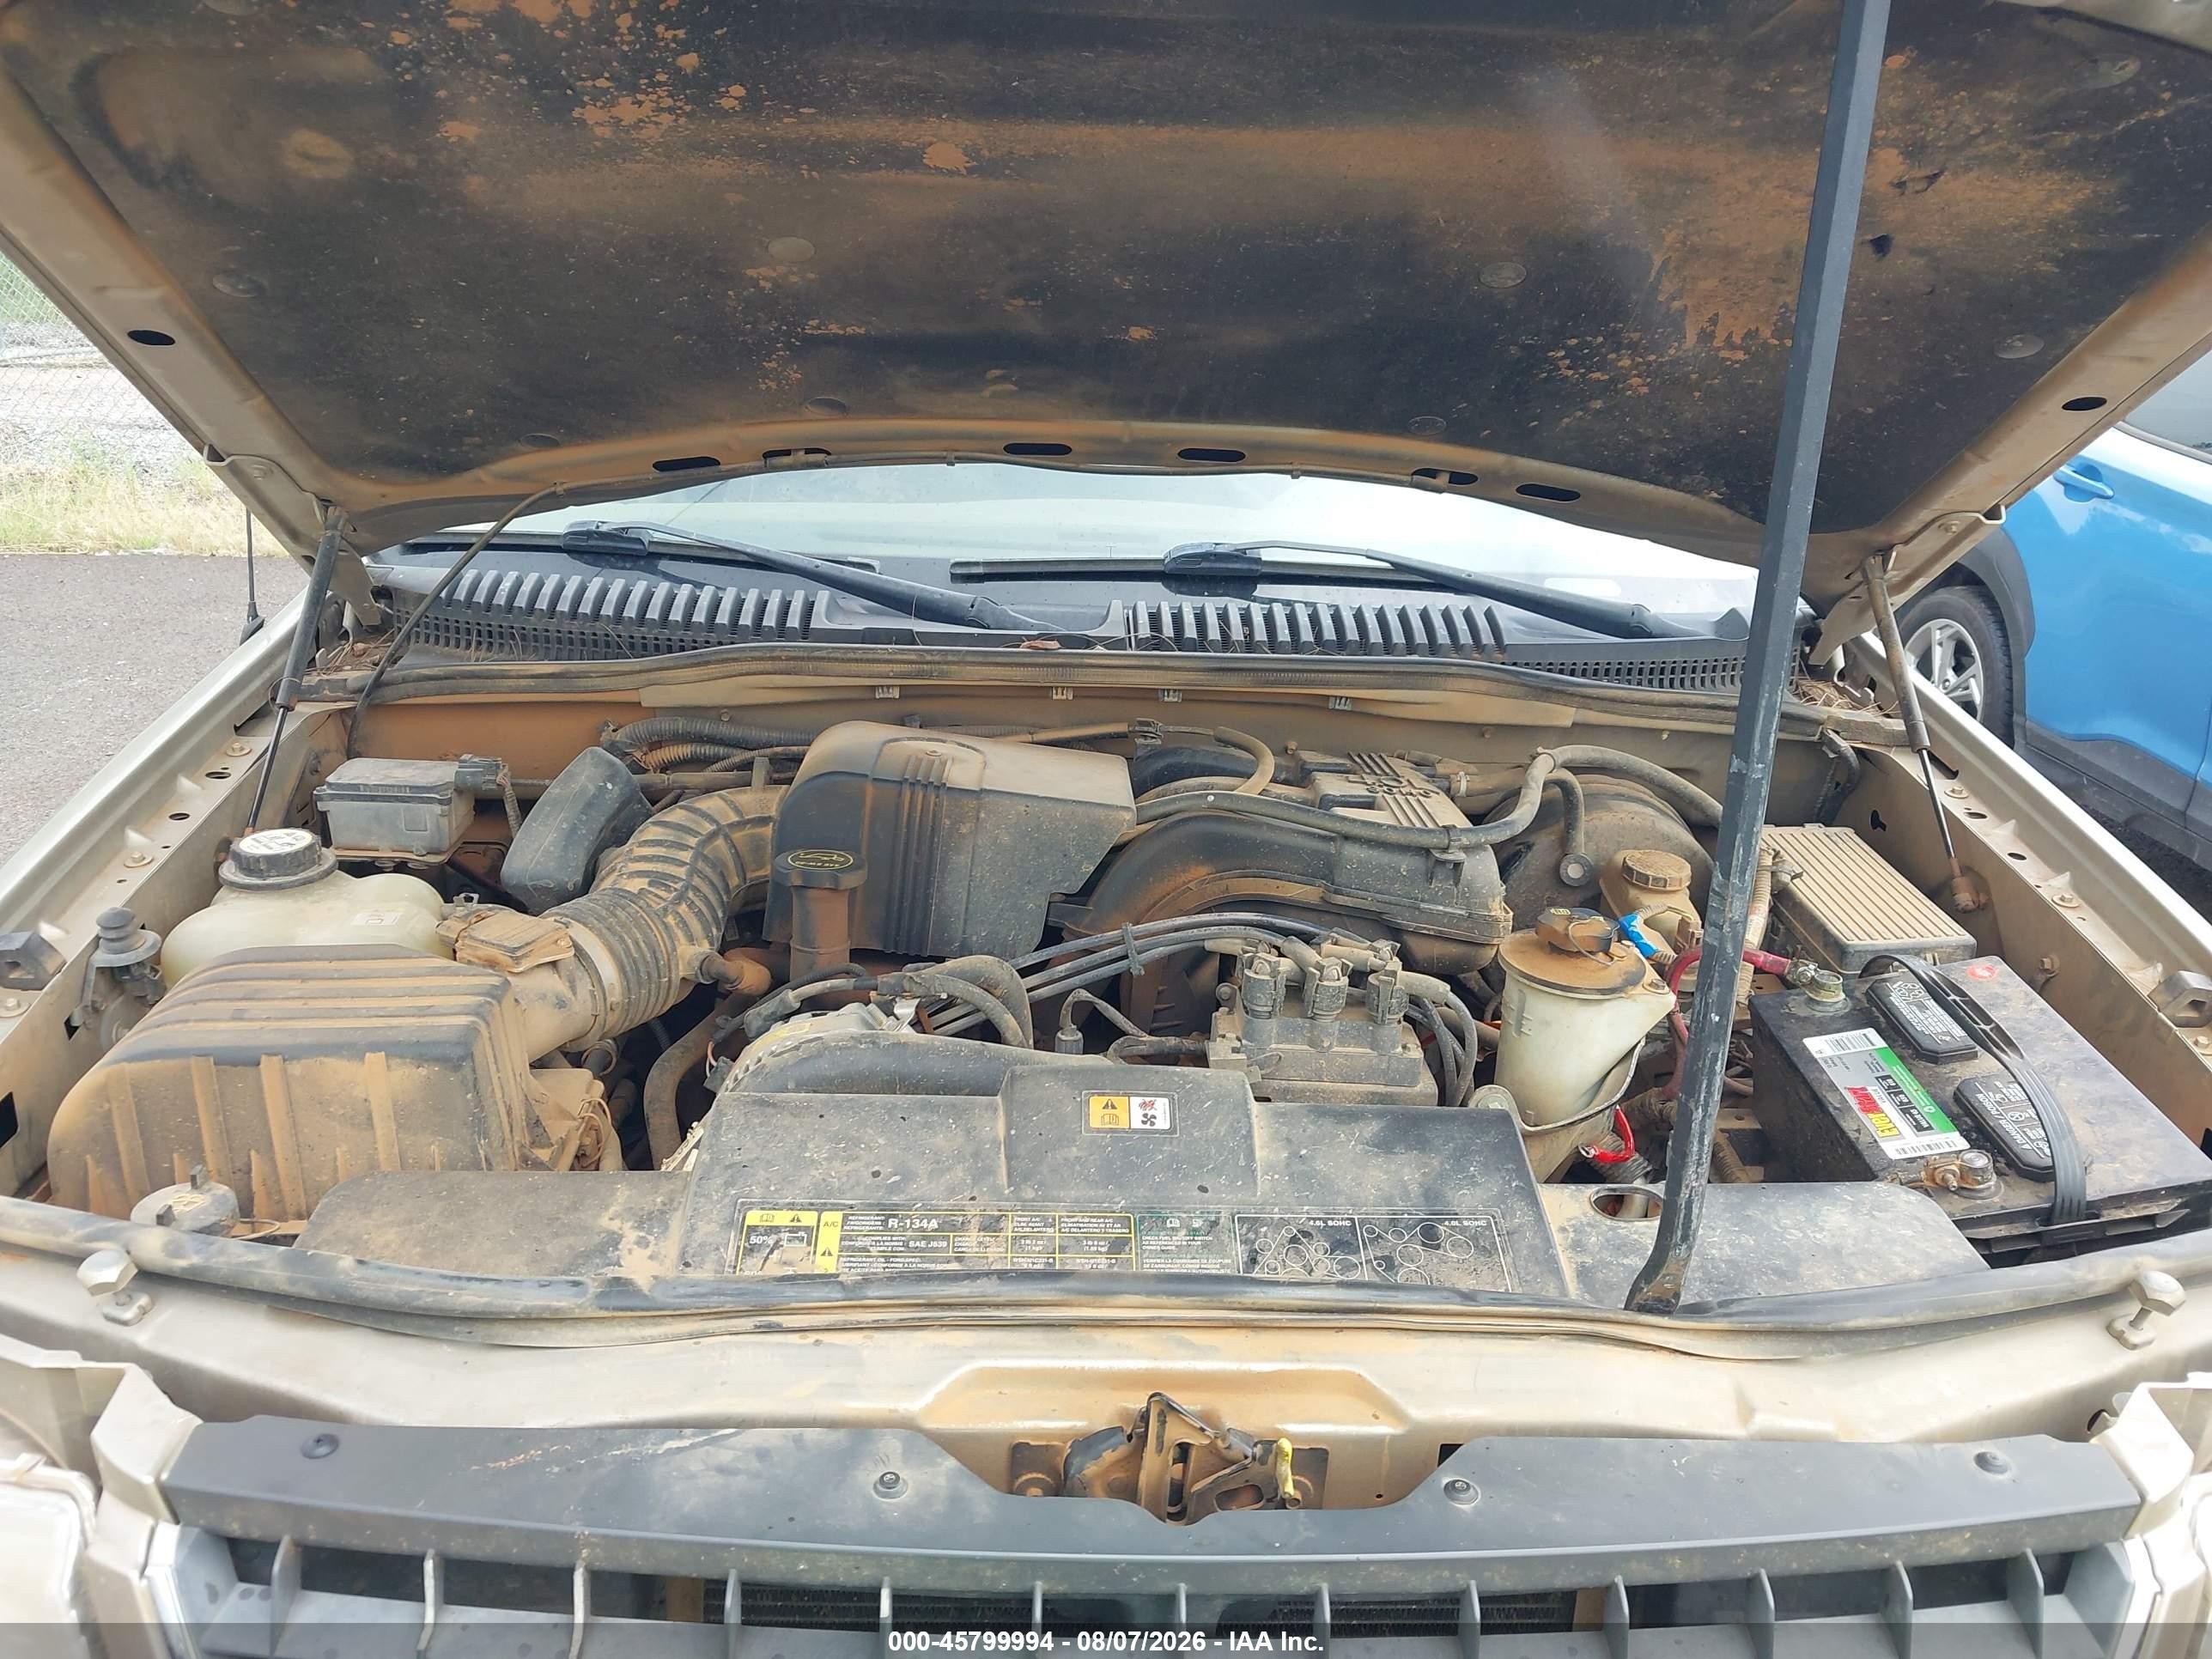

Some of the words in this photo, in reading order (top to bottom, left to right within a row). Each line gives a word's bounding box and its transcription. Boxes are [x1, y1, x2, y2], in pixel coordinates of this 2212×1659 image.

[1844, 1086, 1901, 1138] EverStart
[1975, 1092, 2001, 1115] POISON
[1998, 1119, 2027, 1144] DANGER
[823, 1220, 839, 1229] A/C
[887, 1218, 939, 1230] R-134A
[749, 1235, 774, 1245] 50%
